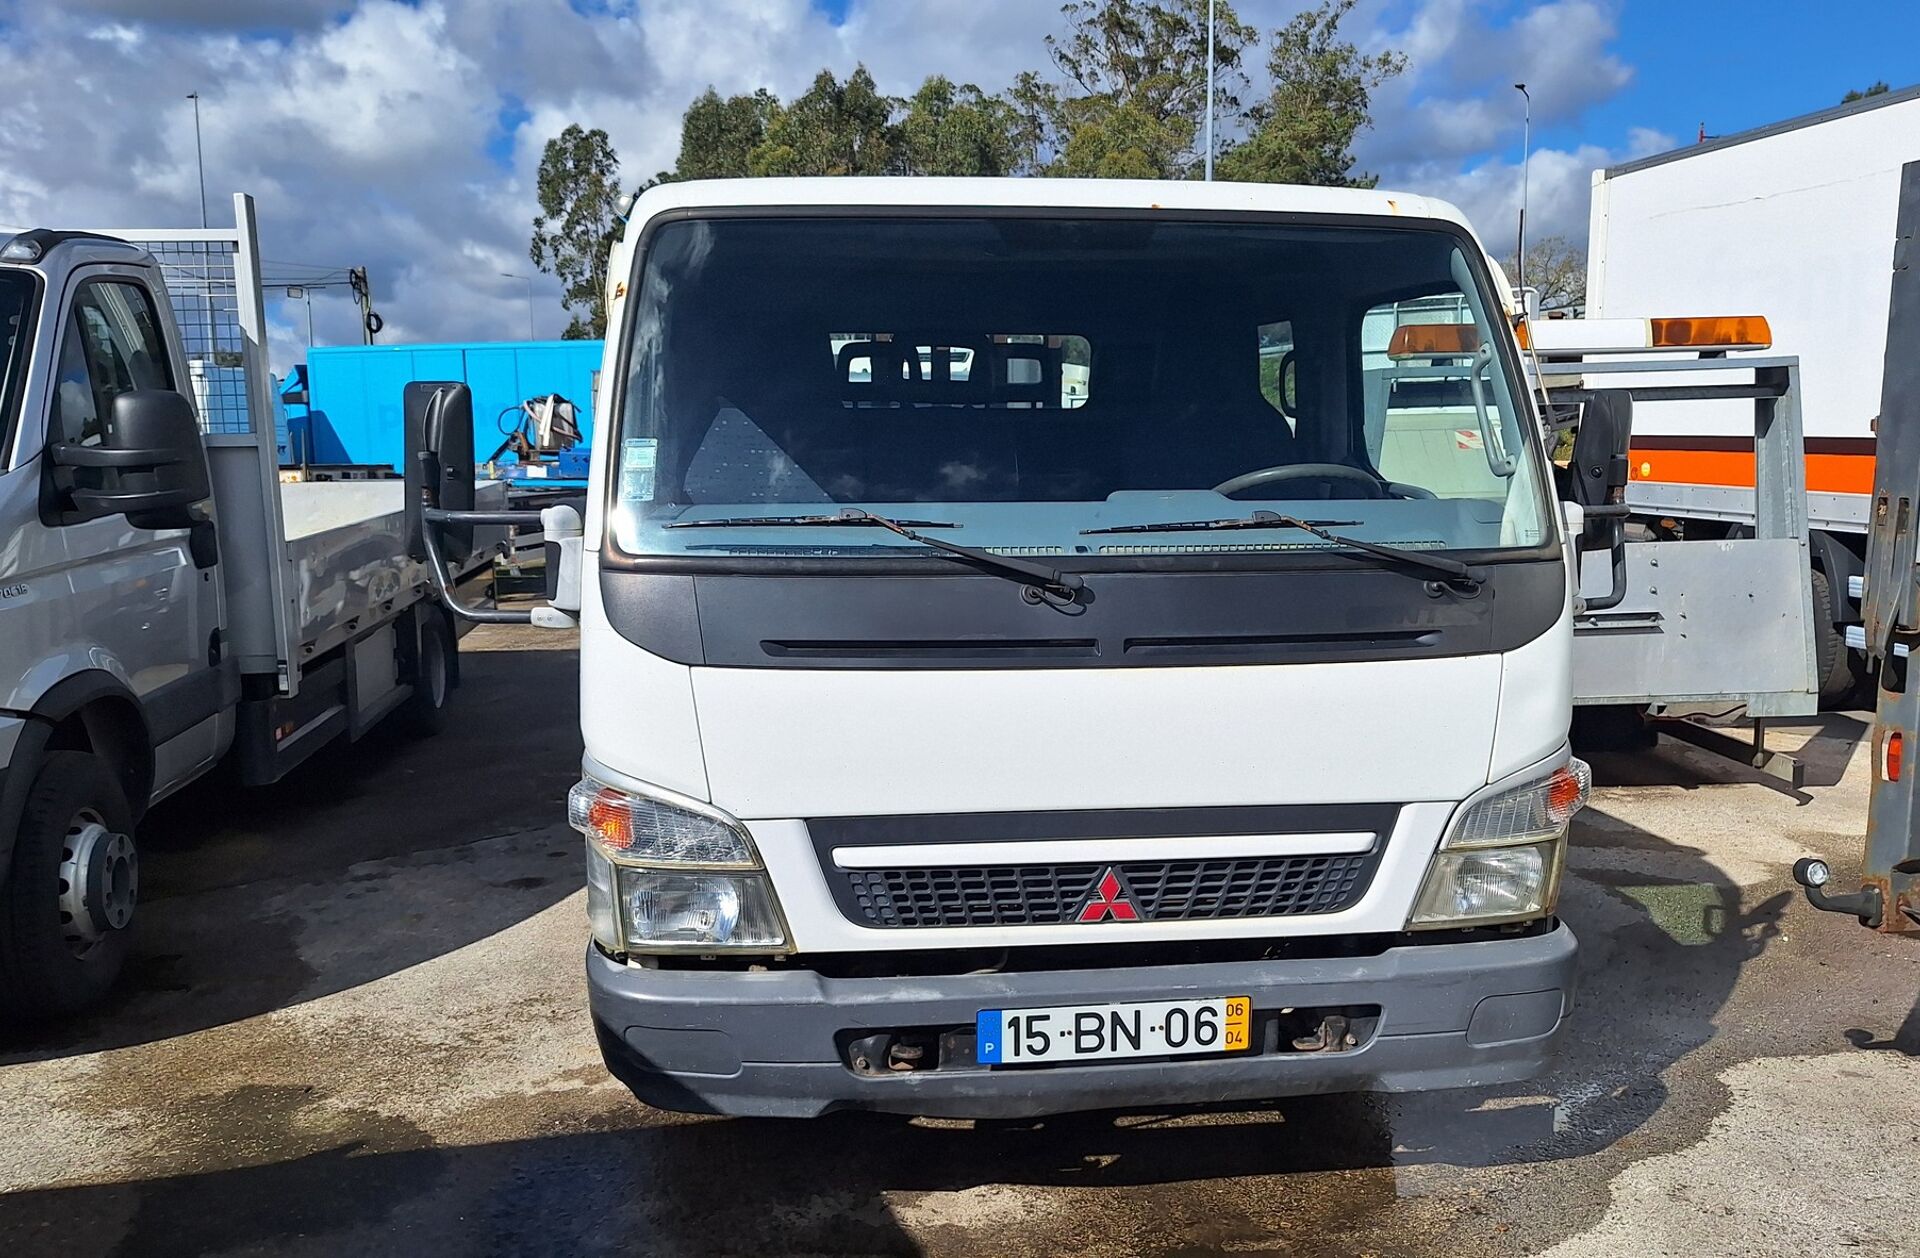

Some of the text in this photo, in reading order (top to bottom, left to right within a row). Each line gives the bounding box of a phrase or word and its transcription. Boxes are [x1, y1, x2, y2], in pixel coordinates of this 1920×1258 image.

[1225, 1003, 1244, 1017] 06
[1225, 1031, 1243, 1045] 04
[985, 1043, 994, 1054] P
